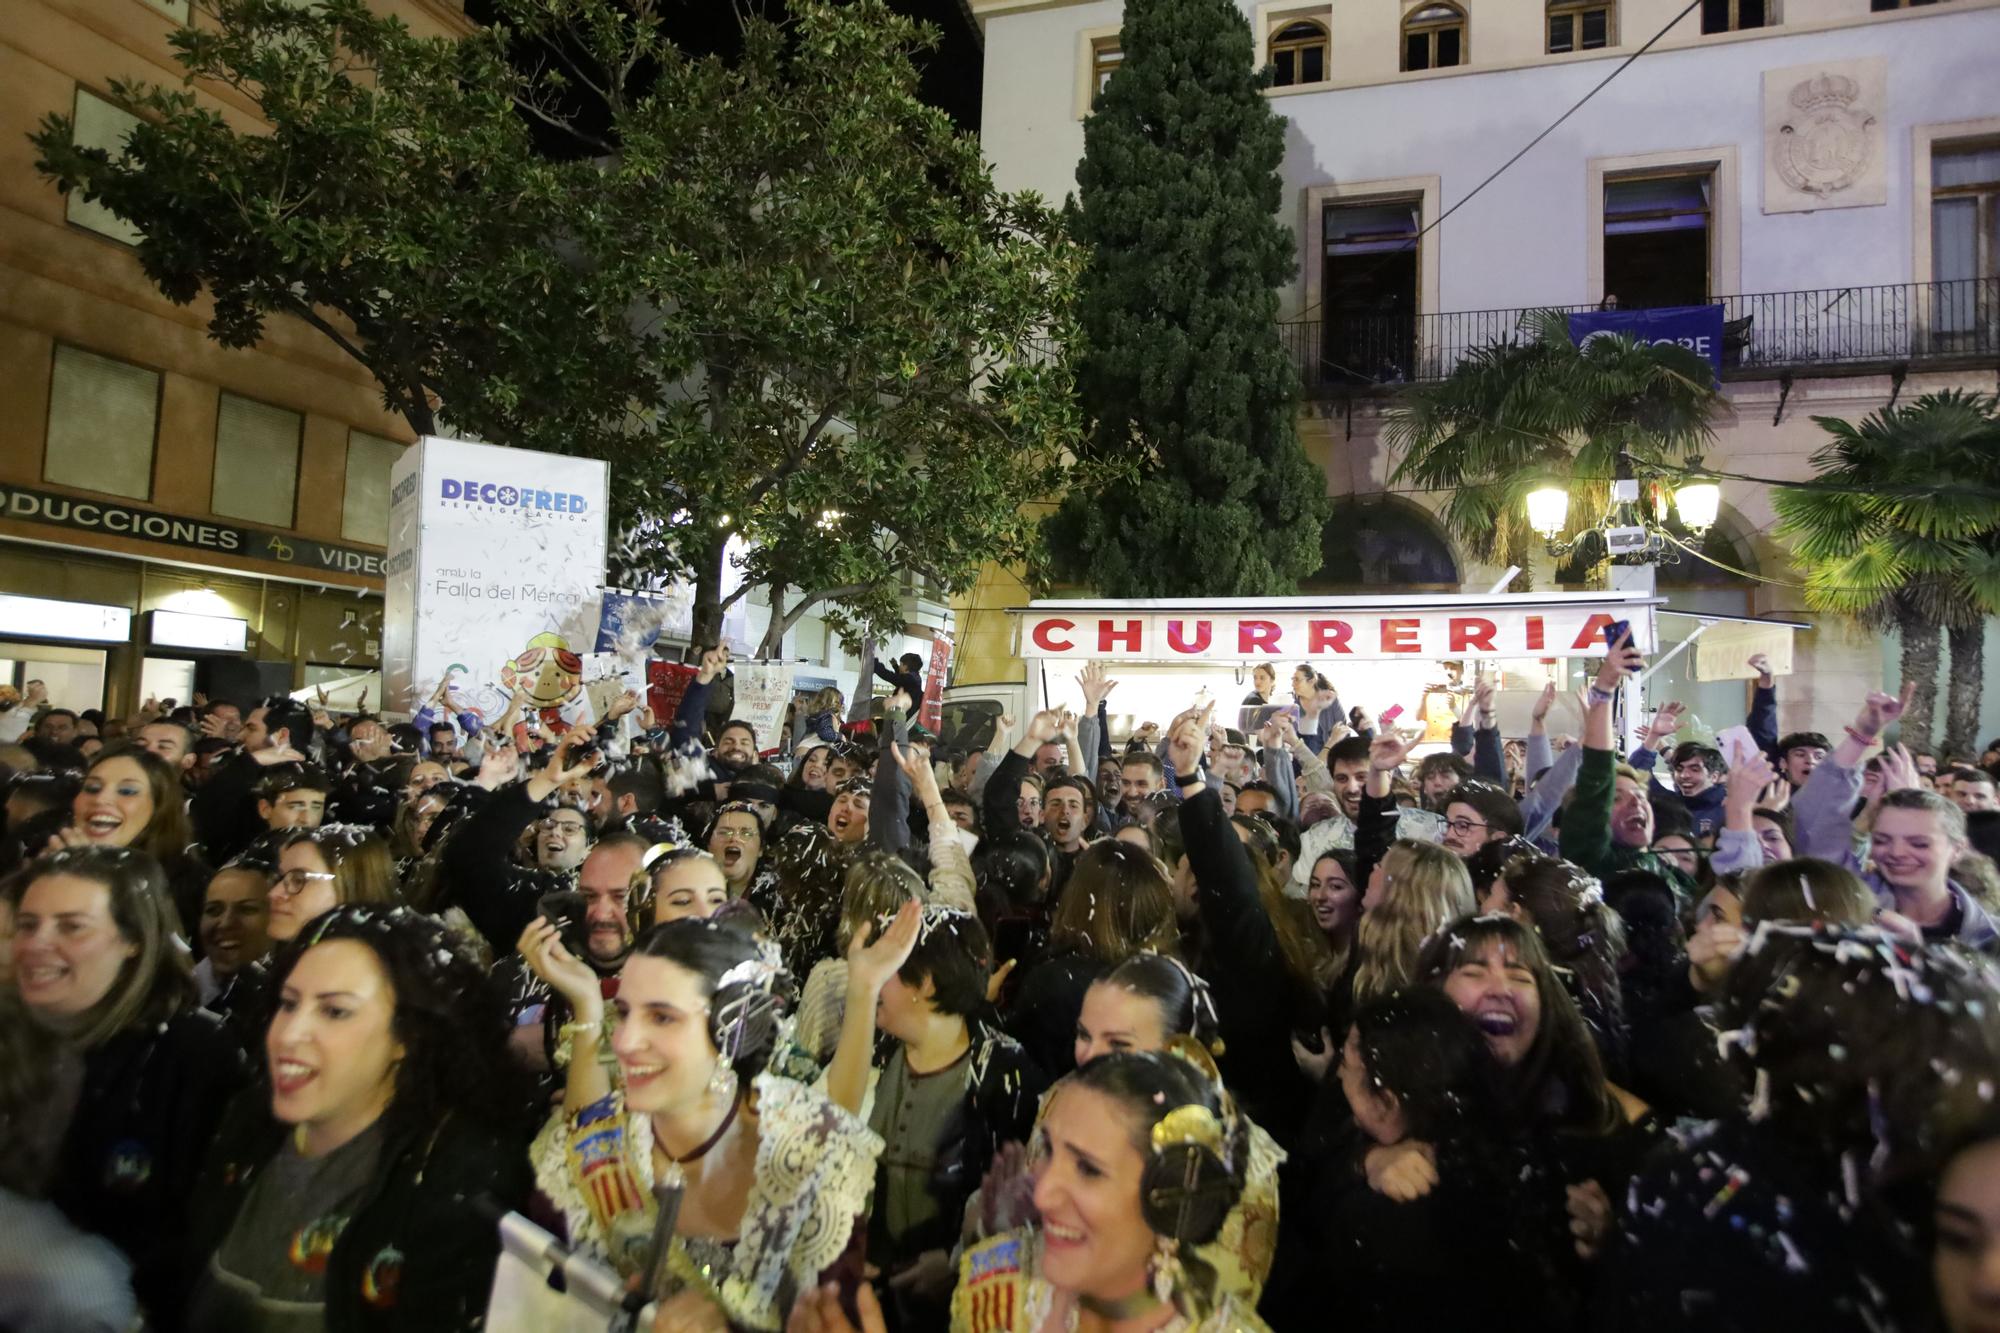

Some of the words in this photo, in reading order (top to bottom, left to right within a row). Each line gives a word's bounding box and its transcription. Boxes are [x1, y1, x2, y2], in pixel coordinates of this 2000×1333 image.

[441, 478, 585, 514] DECOFRED
[0, 491, 239, 550] DUCCIONES
[436, 580, 481, 598] Falla
[487, 585, 516, 601] del
[1032, 613, 1616, 654] CHURRERIA
